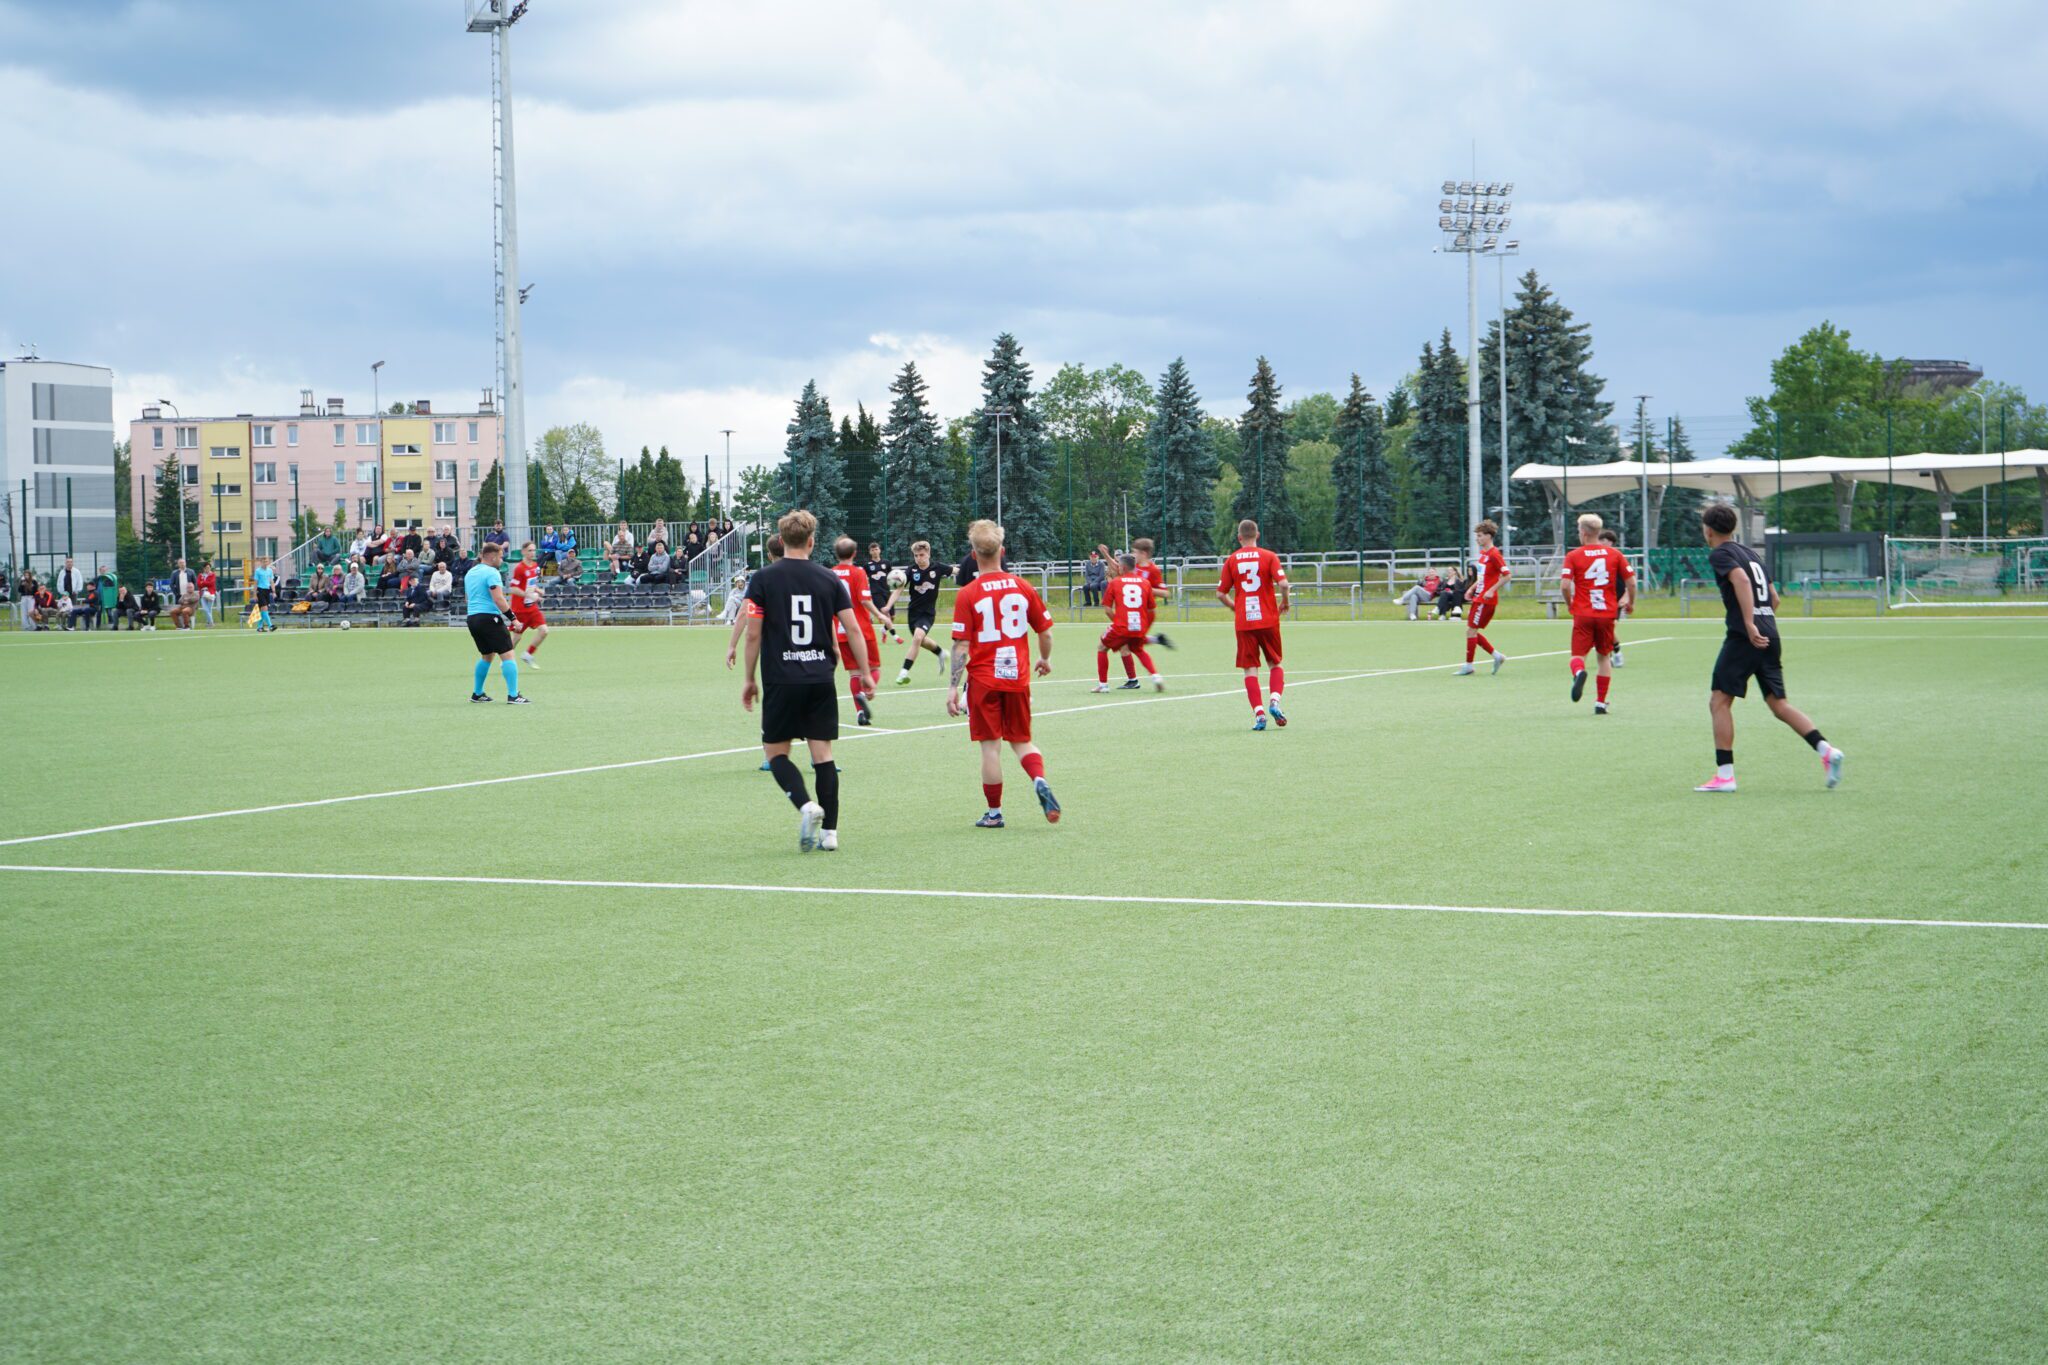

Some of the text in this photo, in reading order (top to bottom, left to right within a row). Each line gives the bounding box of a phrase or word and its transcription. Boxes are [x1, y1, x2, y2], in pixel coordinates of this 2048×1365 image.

[982, 579, 1018, 591] UNIA
[1237, 561, 1261, 592] 3
[1584, 558, 1610, 587] 4
[1749, 561, 1769, 601] 9
[747, 602, 756, 614] C
[1122, 584, 1143, 609] 8
[791, 595, 813, 645] 5
[974, 593, 1028, 642] 18
